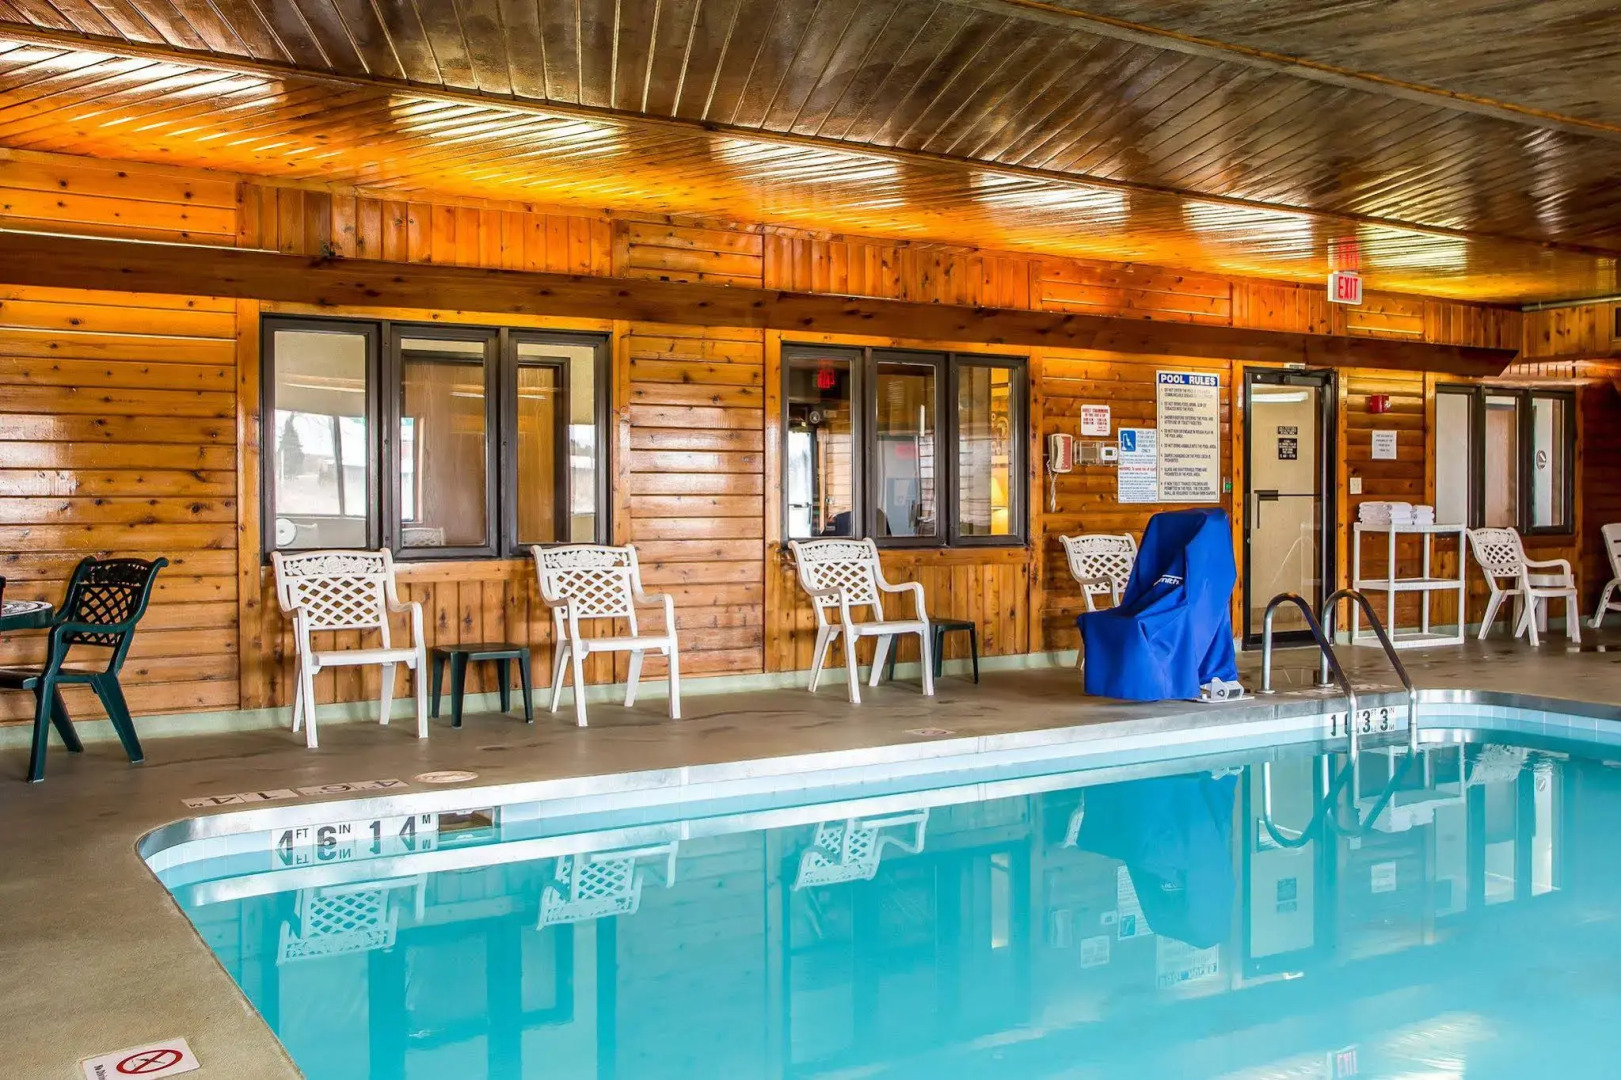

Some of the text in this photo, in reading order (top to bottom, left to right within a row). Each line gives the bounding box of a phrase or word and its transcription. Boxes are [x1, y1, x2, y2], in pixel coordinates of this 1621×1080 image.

[1337, 276, 1358, 300] EXIT
[1160, 374, 1216, 385] POOL RULES
[277, 830, 293, 850] 4
[296, 828, 309, 839] FT
[317, 825, 337, 847] 6
[339, 824, 351, 834] IN
[422, 814, 431, 824] M
